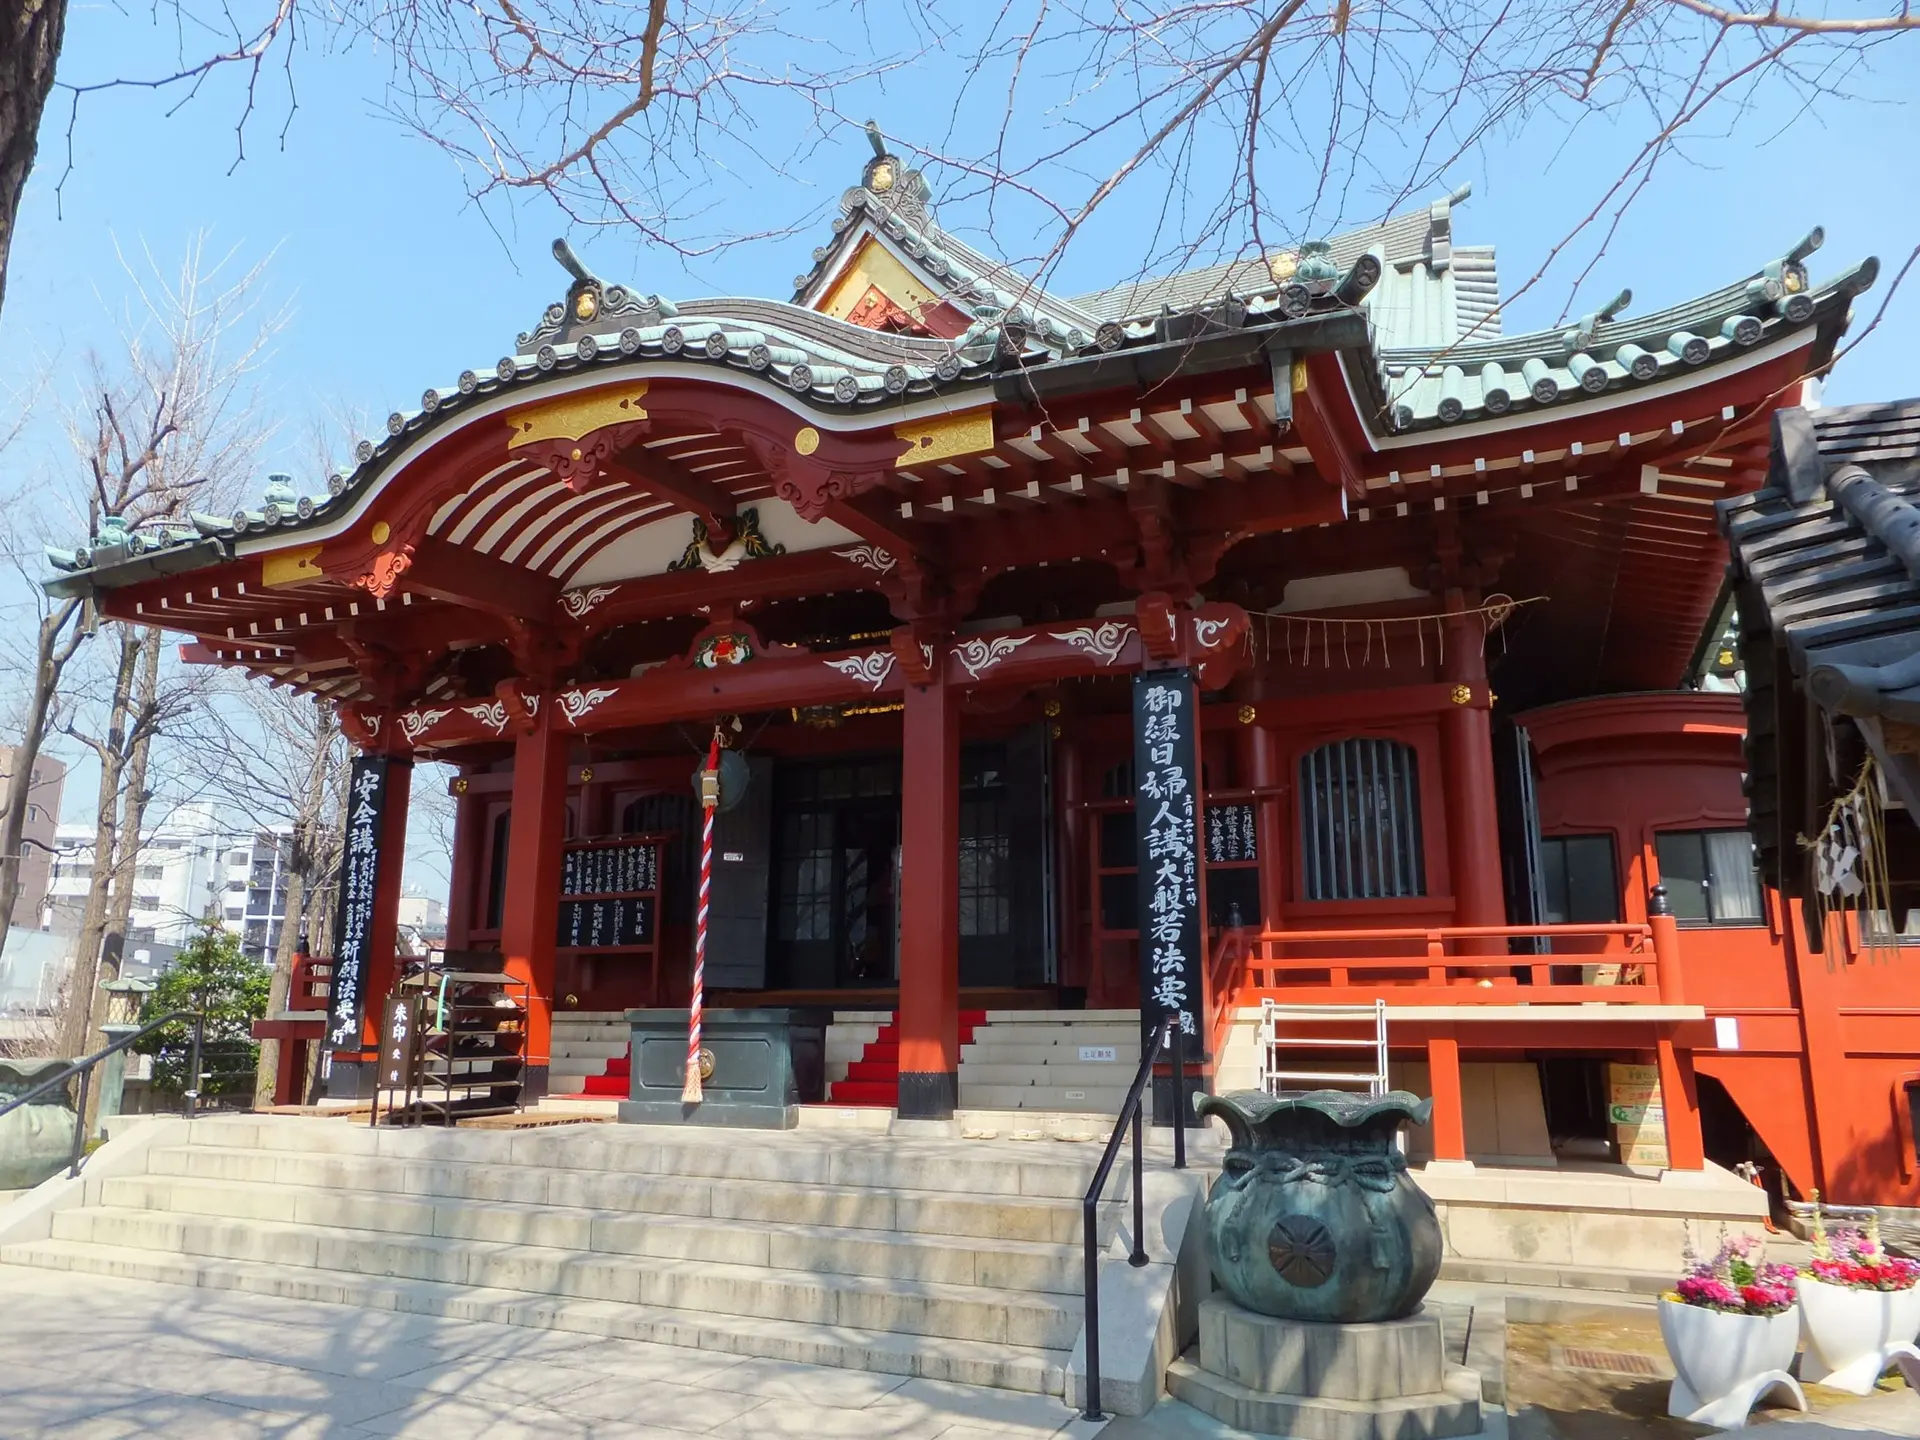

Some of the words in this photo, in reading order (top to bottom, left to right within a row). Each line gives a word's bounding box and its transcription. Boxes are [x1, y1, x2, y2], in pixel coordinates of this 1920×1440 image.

[349, 769, 379, 855] 安全講
[392, 1002, 408, 1043] 朱印
